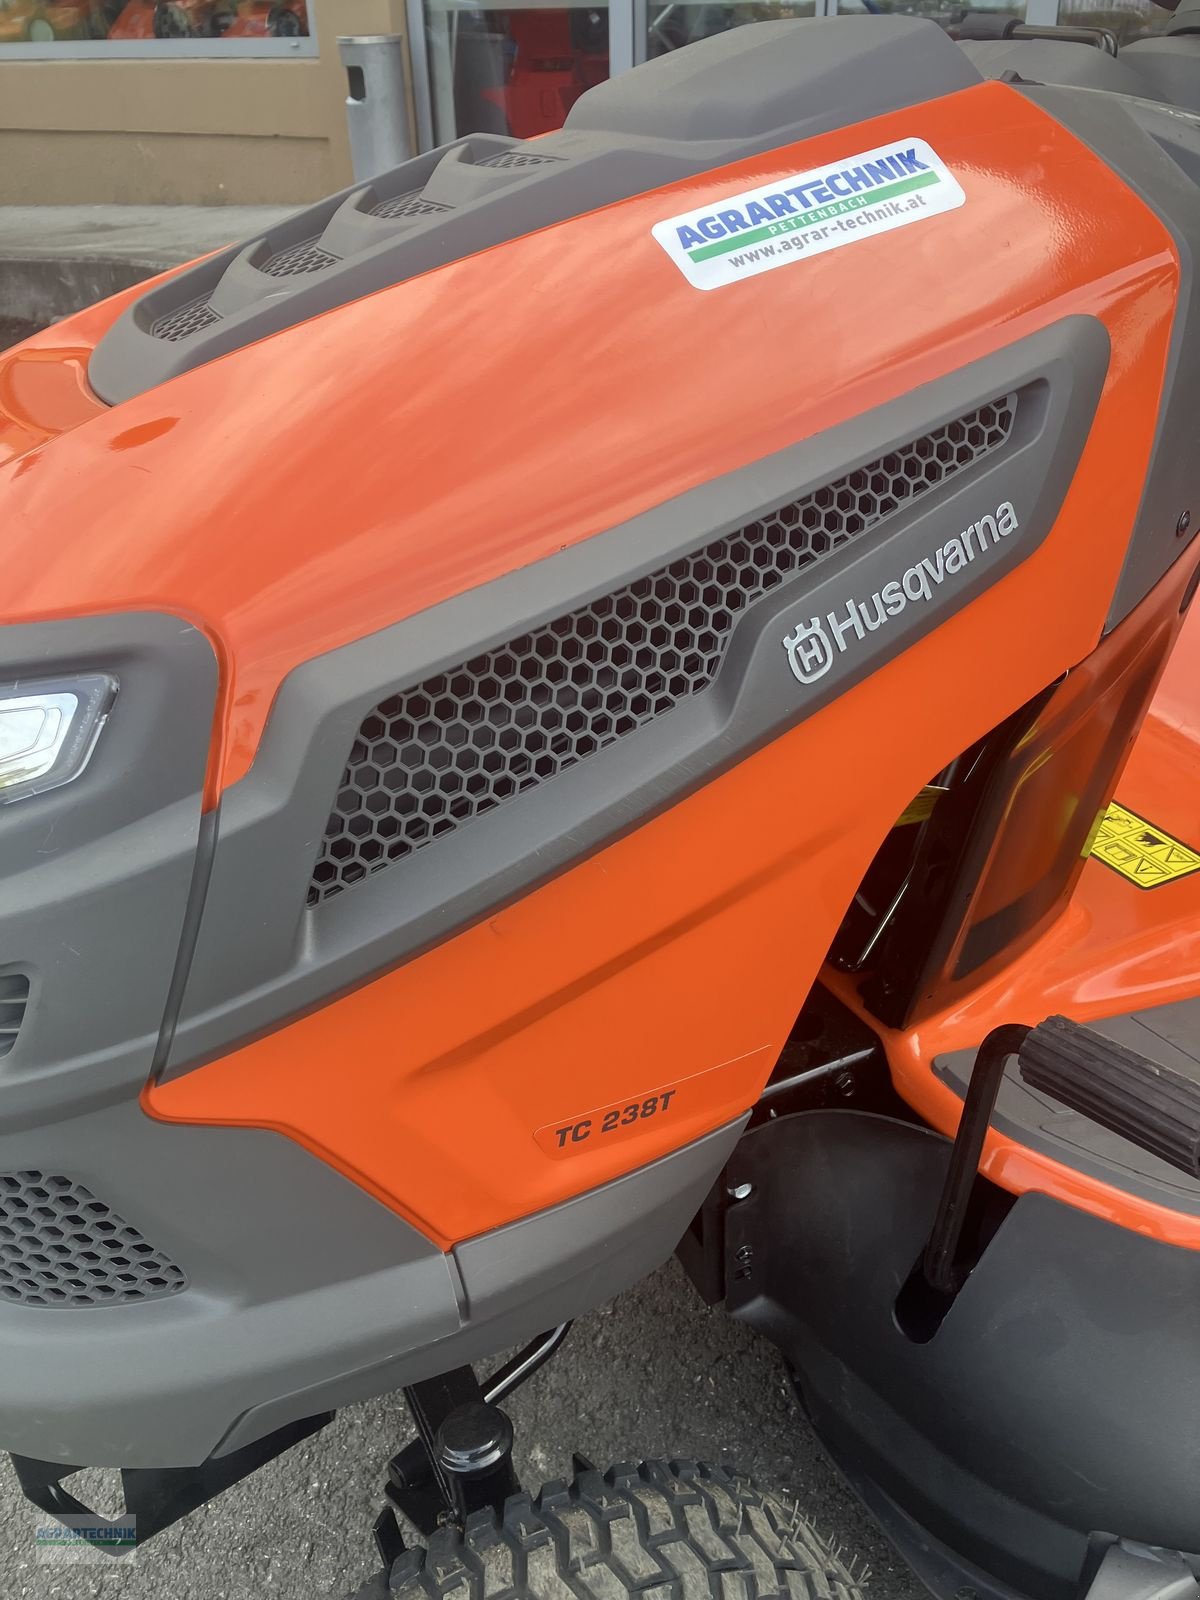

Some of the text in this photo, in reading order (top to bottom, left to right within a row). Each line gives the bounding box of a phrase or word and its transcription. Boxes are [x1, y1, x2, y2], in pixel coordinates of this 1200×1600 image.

[675, 148, 930, 249] AGRARTECHNIK
[728, 193, 927, 268] www.agrar-technik.at
[768, 196, 868, 235] PETTENBACH
[827, 501, 1019, 652] Husqvarna
[555, 1090, 676, 1148] TC 238T
